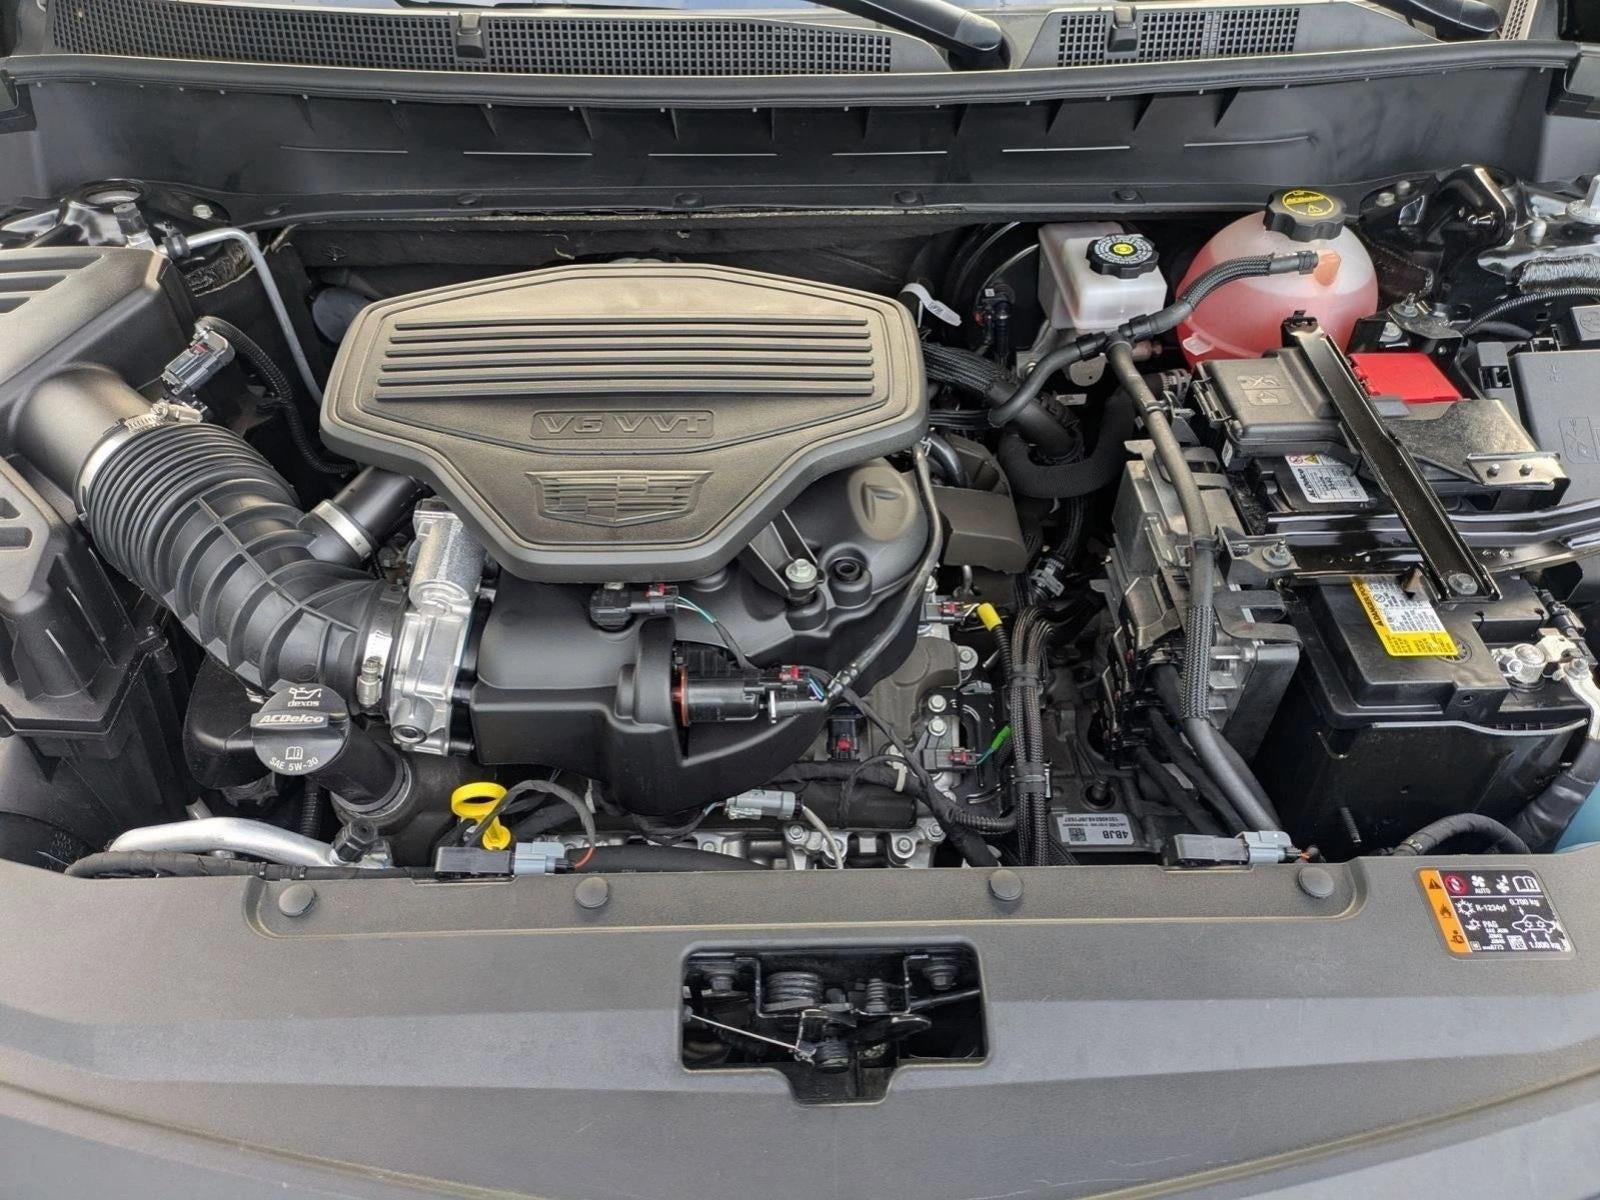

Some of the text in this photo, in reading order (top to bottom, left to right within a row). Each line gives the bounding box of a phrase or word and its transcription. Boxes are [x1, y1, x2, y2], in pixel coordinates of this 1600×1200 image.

[540, 415, 708, 434] V6 VVT
[288, 700, 320, 708] dexos
[259, 714, 325, 723] ACDelco
[269, 756, 319, 771] SAE 5W-30
